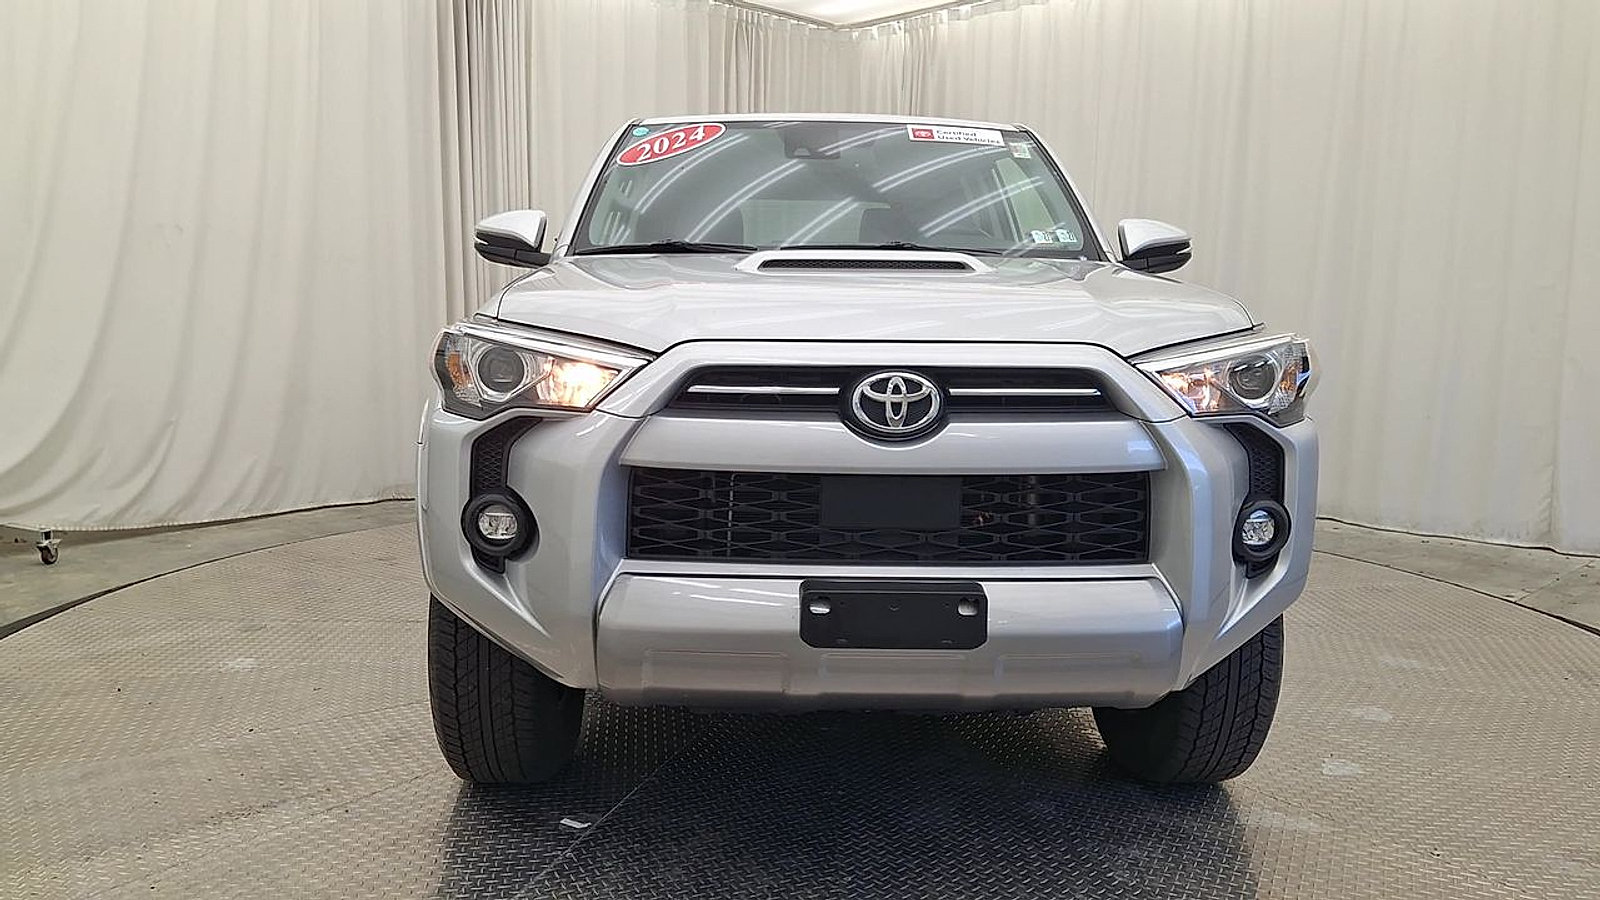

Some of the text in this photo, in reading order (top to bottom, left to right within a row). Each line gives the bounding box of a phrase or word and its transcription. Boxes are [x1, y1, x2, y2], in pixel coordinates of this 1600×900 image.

[936, 129, 977, 137] Certified
[636, 125, 705, 162] 2024
[963, 136, 1001, 144] Vehicles
